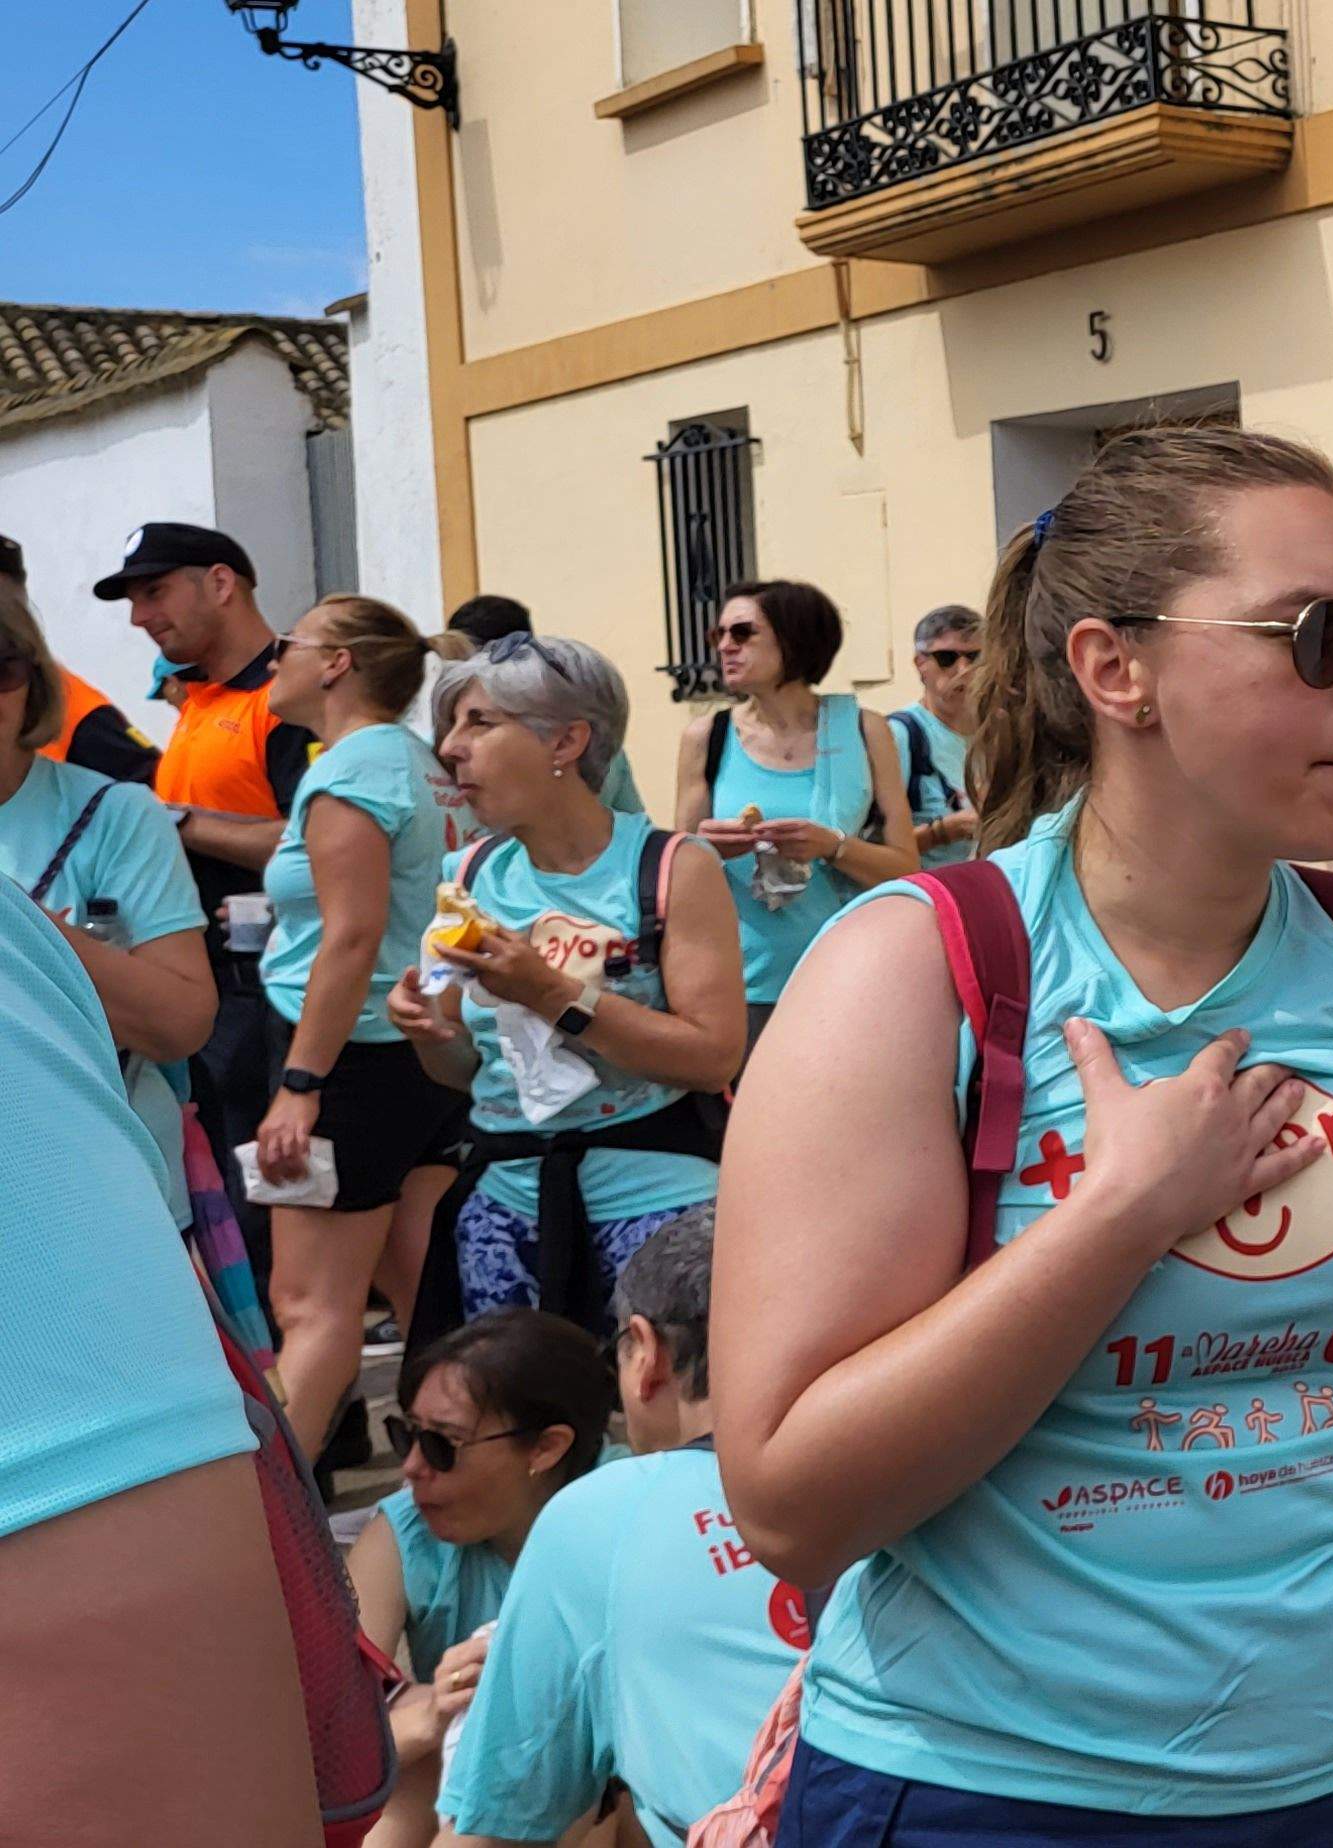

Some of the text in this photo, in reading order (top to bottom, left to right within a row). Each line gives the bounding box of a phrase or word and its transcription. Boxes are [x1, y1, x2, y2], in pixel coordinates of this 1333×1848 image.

[1088, 311, 1111, 362] 5
[1196, 1321, 1320, 1364] Marcha
[1074, 1475, 1185, 1507] ASPACE
